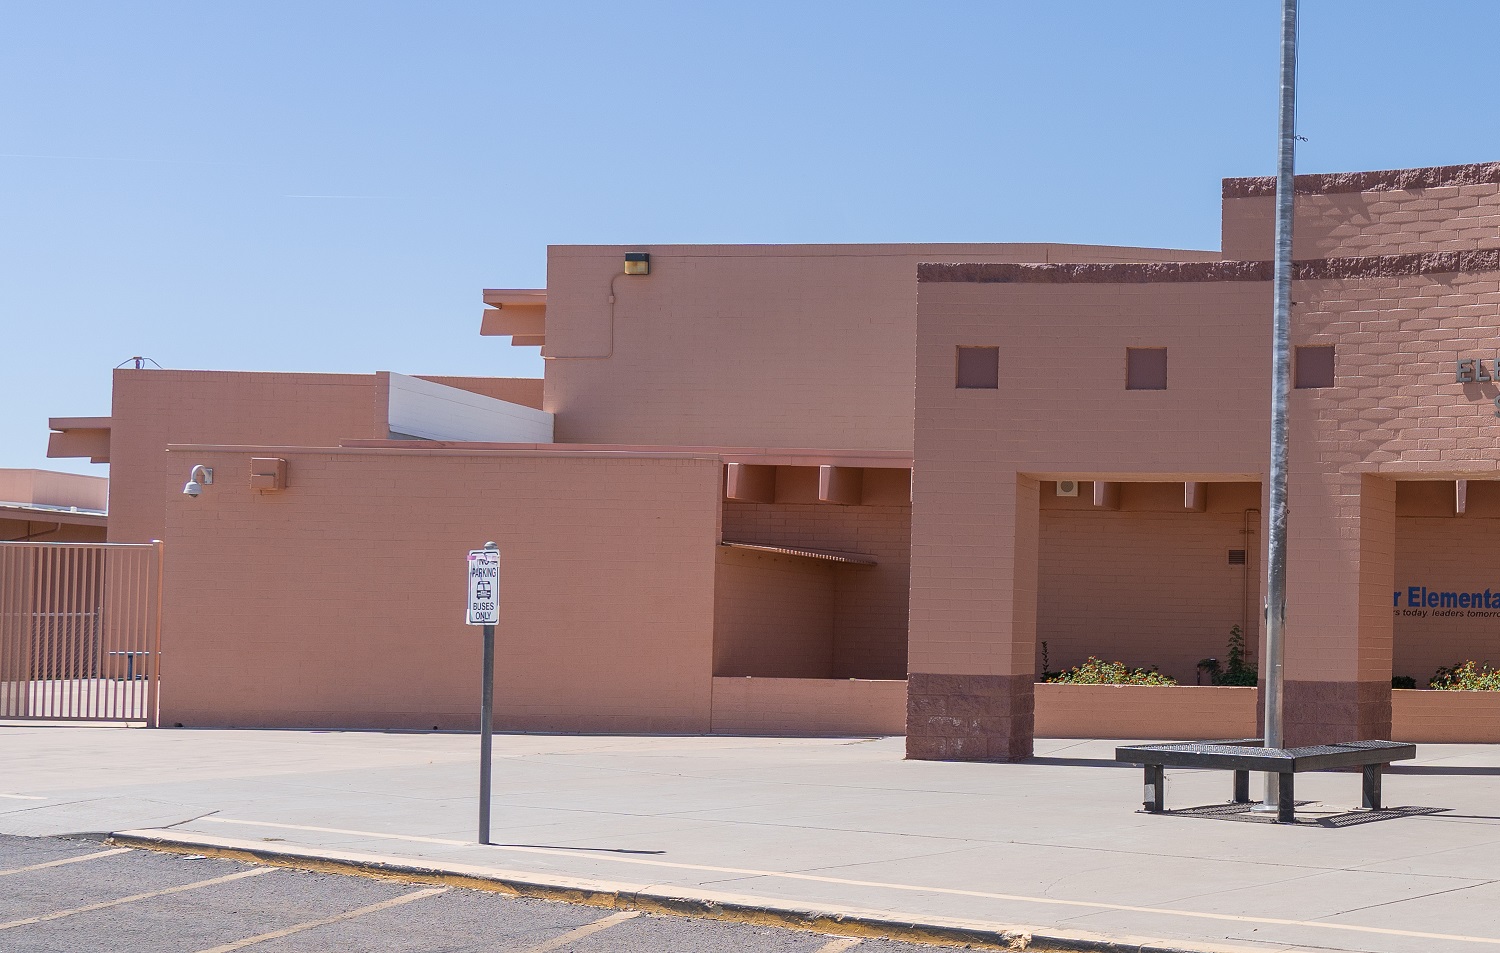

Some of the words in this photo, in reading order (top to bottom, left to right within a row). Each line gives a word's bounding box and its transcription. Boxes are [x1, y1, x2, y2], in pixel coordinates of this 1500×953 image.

[472, 568, 496, 577] PARKING
[473, 602, 494, 611] BUSES
[475, 611, 492, 620] ONLY
[1431, 609, 1464, 618] leaders
